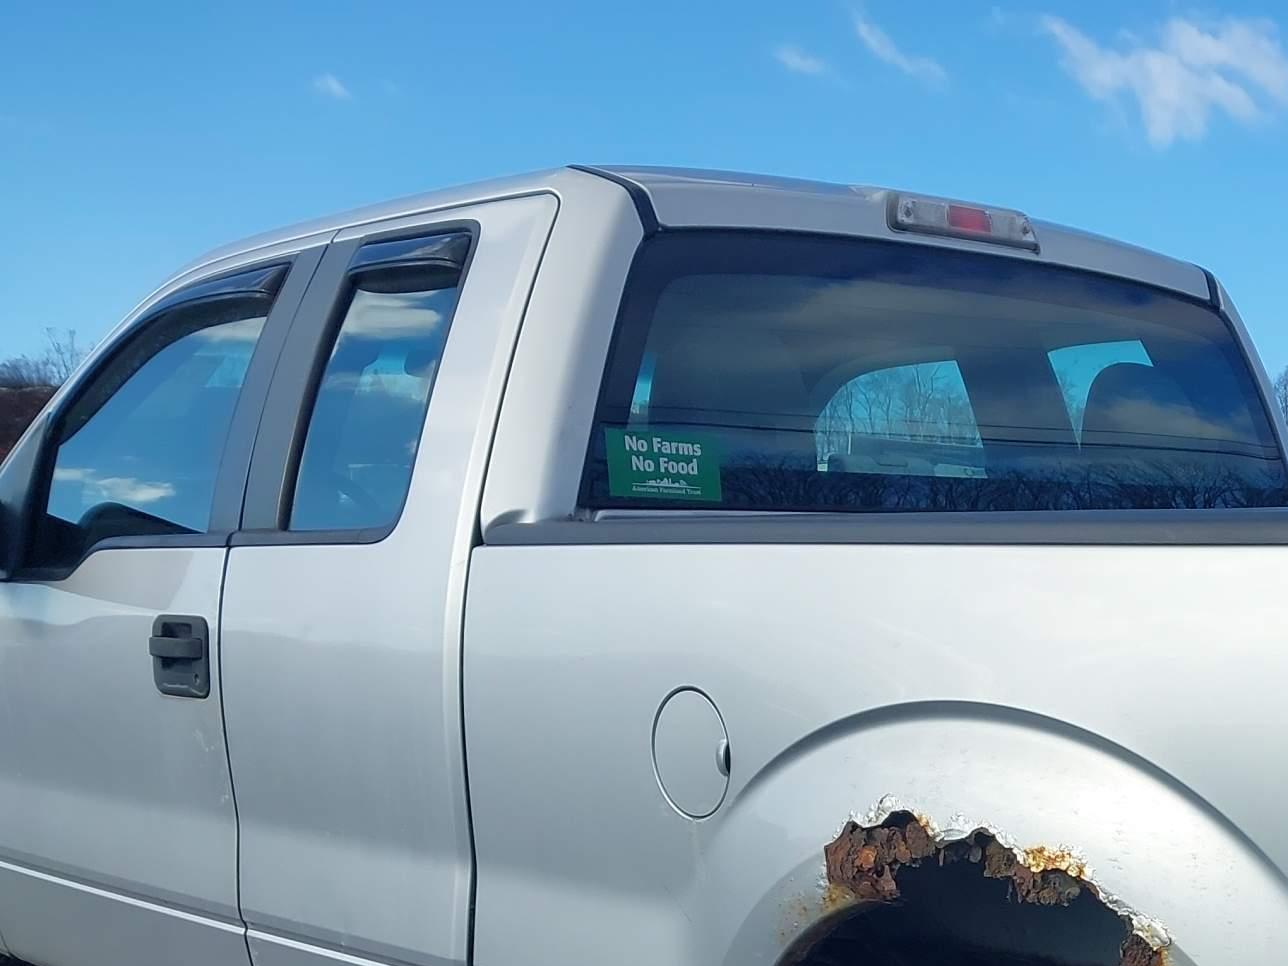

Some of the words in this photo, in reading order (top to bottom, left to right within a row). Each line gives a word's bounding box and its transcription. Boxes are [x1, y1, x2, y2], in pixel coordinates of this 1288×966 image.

[624, 435, 648, 452] No
[652, 437, 702, 456] Farms
[631, 455, 655, 472] No
[659, 457, 698, 475] Food
